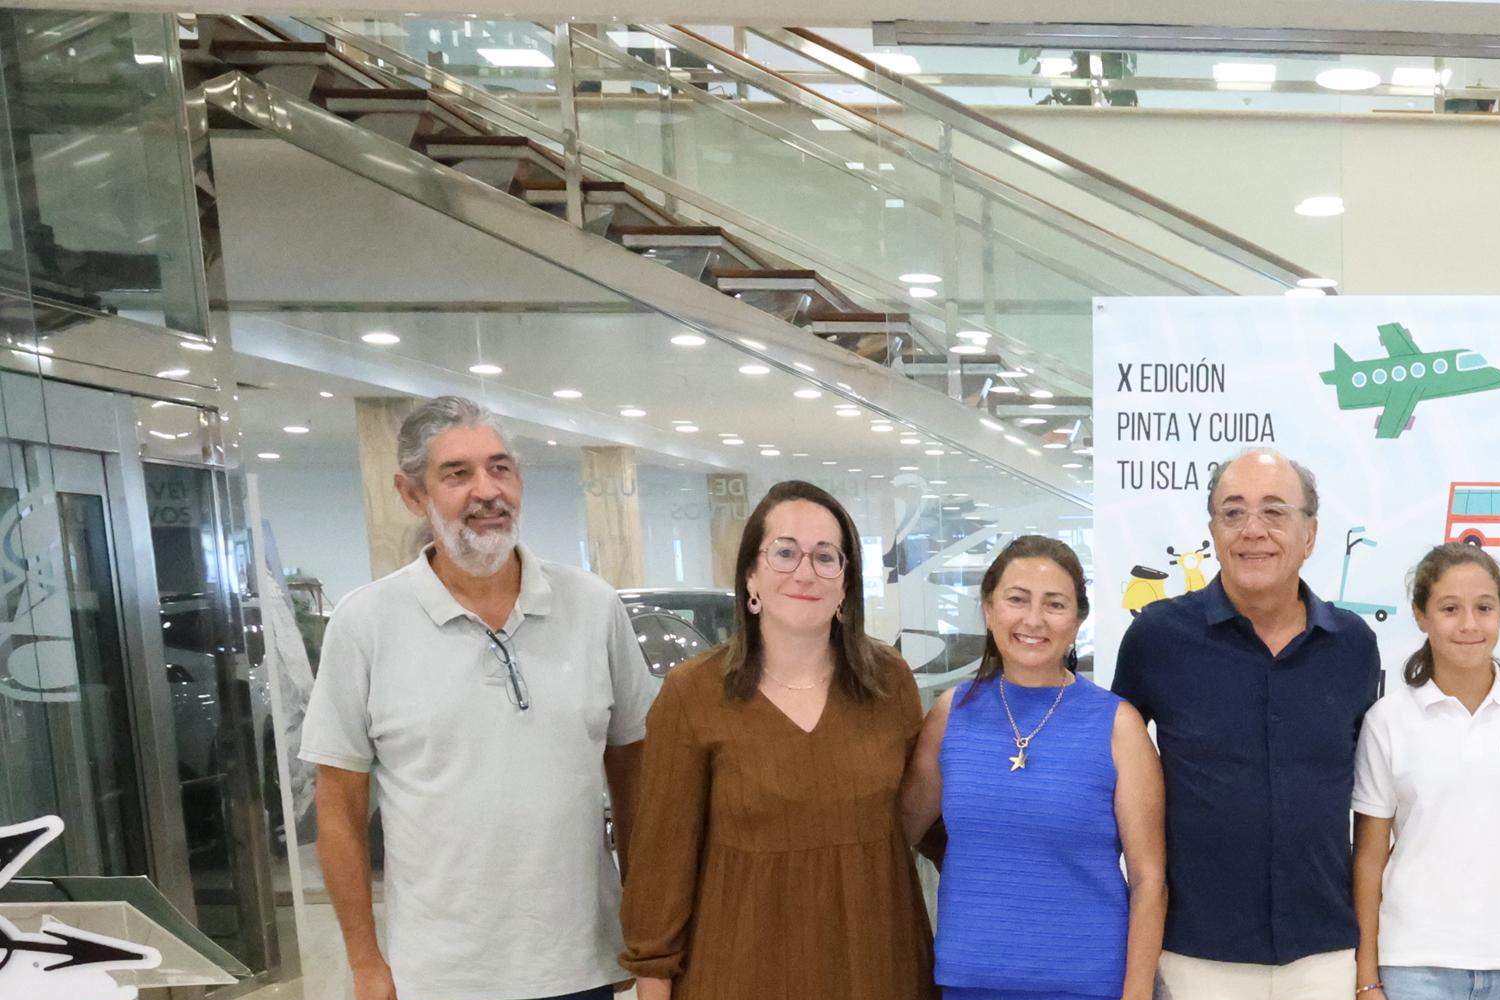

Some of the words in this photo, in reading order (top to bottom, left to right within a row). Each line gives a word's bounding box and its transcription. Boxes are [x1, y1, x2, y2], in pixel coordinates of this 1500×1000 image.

[1117, 362, 1133, 392] X
[1140, 357, 1225, 393] EDICIÓN
[1117, 411, 1180, 441] PINTA
[1188, 412, 1202, 442] Y
[1209, 412, 1275, 442] CUIDA
[1117, 460, 1143, 490] TU
[1151, 460, 1199, 490] ISLA
